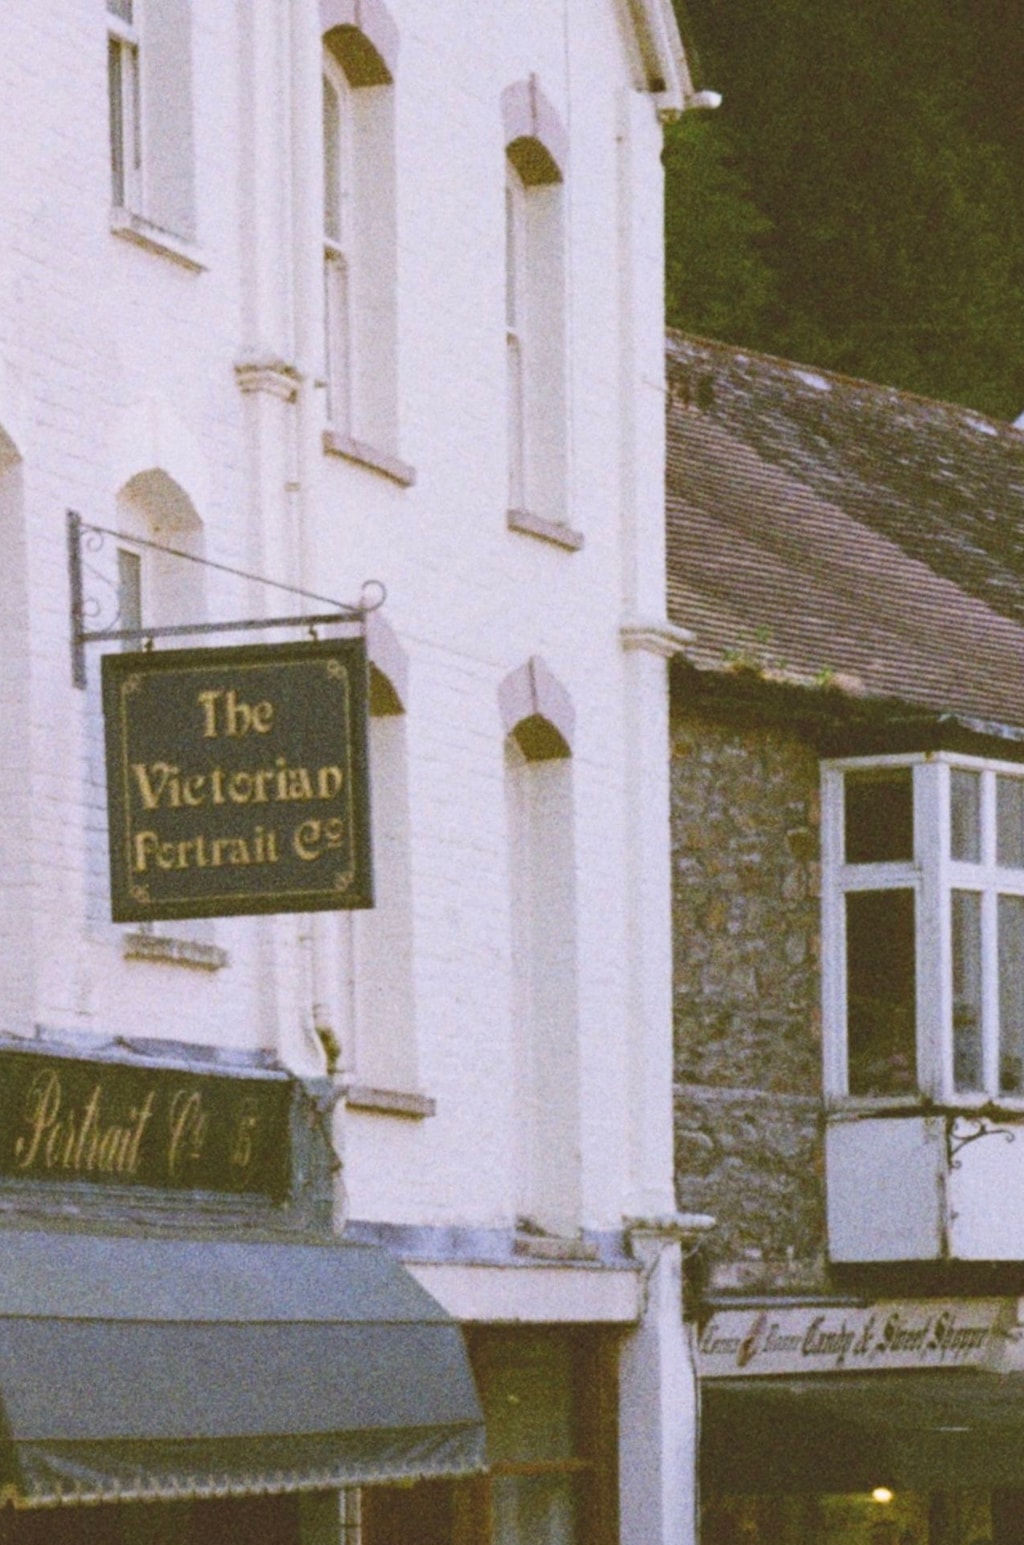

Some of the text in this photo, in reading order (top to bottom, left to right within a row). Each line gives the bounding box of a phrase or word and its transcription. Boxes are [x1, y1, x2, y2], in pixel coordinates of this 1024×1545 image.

[198, 688, 274, 739] The
[130, 756, 343, 811] Victorian
[133, 825, 280, 873] Portrait
[15, 1067, 154, 1174] Portrait
